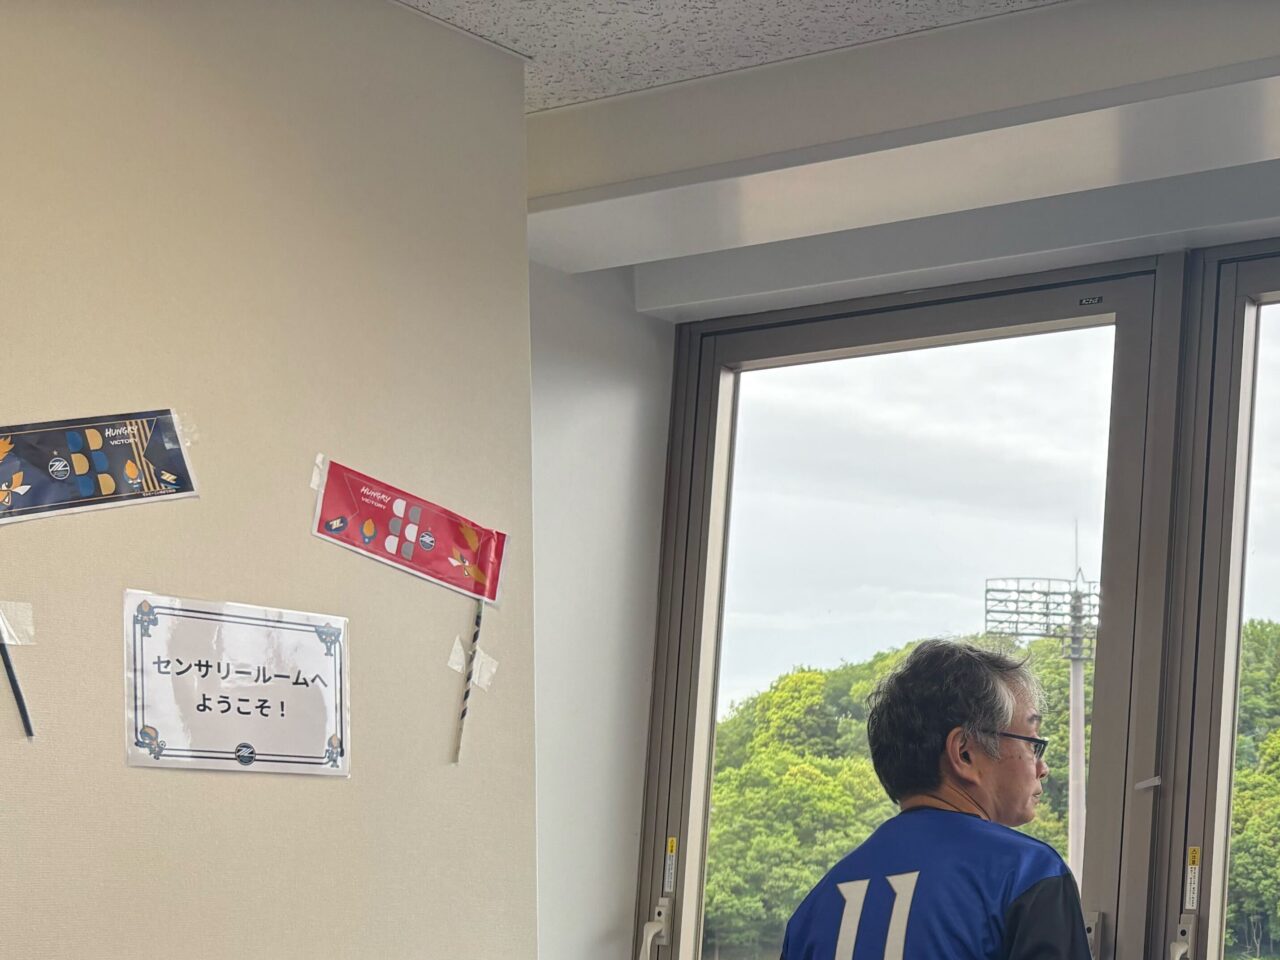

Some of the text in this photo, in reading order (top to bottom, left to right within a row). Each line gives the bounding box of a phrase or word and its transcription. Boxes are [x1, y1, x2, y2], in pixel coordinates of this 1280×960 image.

[152, 655, 328, 688] センサリールームへ
